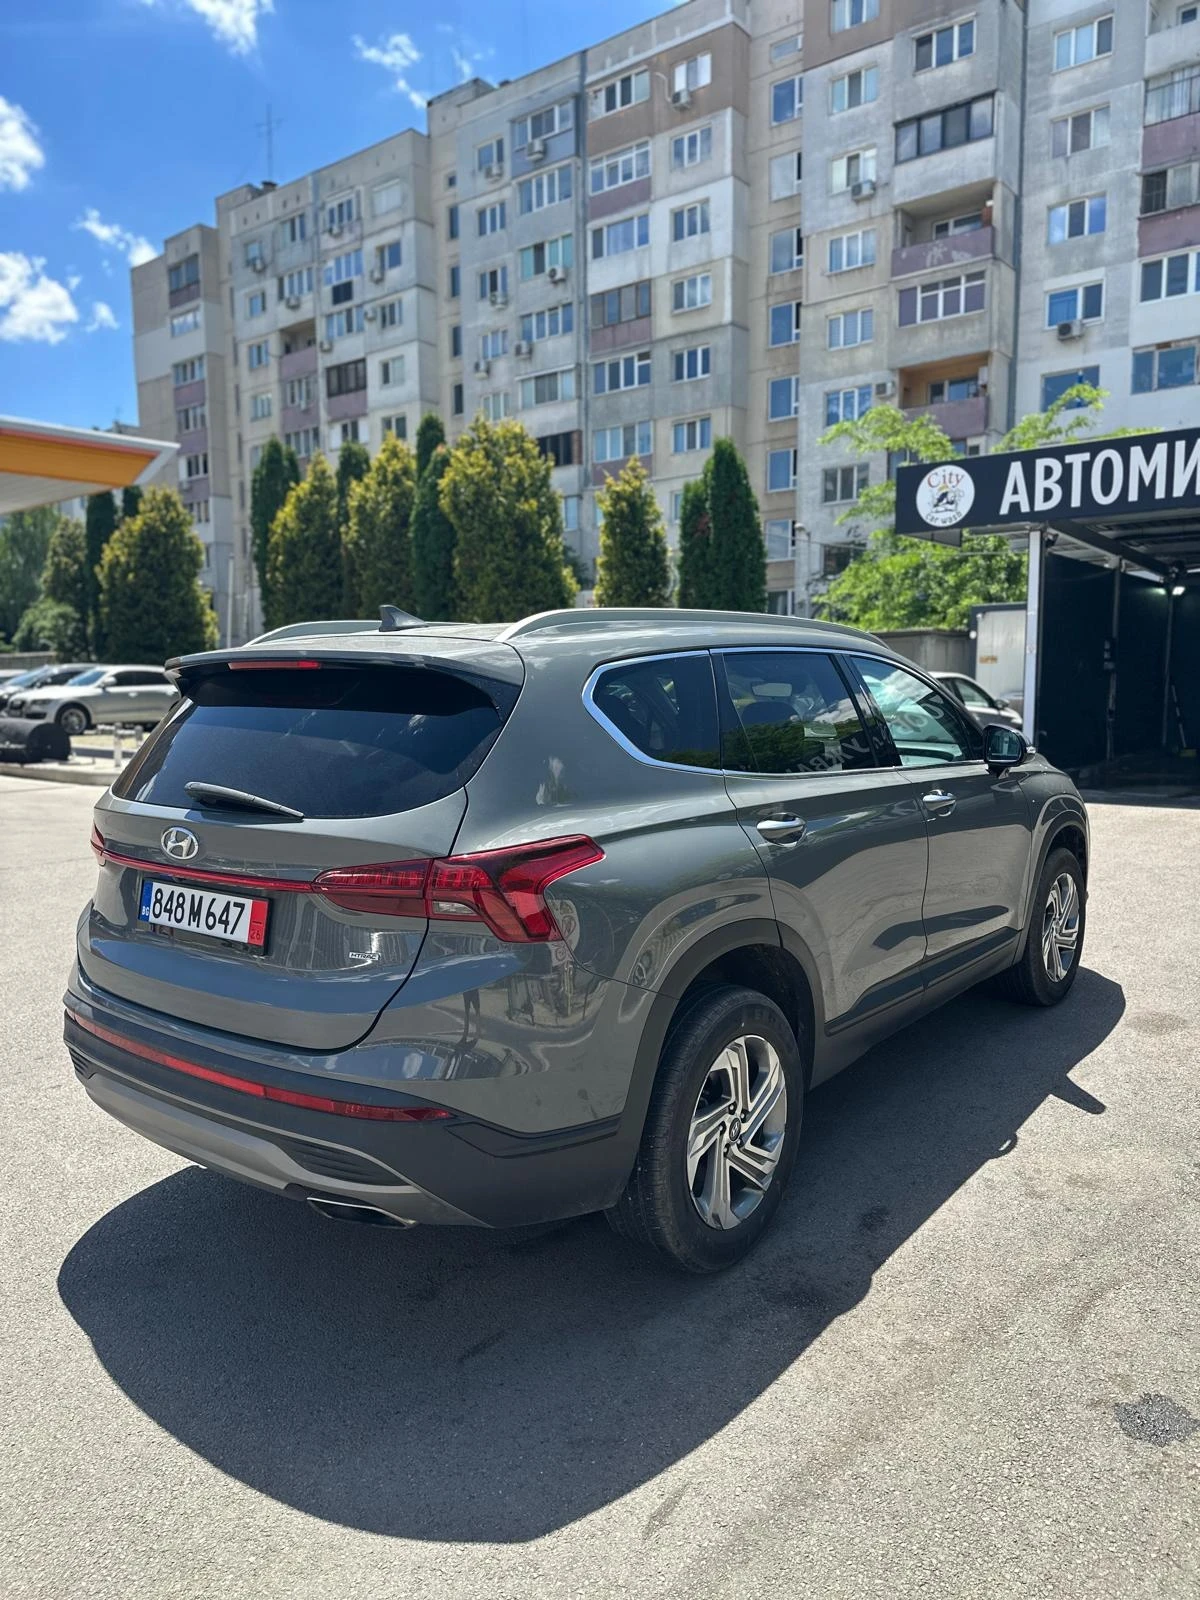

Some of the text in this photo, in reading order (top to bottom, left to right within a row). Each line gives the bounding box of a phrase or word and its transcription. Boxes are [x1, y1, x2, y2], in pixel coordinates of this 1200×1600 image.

[927, 469, 964, 489] City
[141, 905, 150, 916] BG
[152, 888, 246, 935] 848M647
